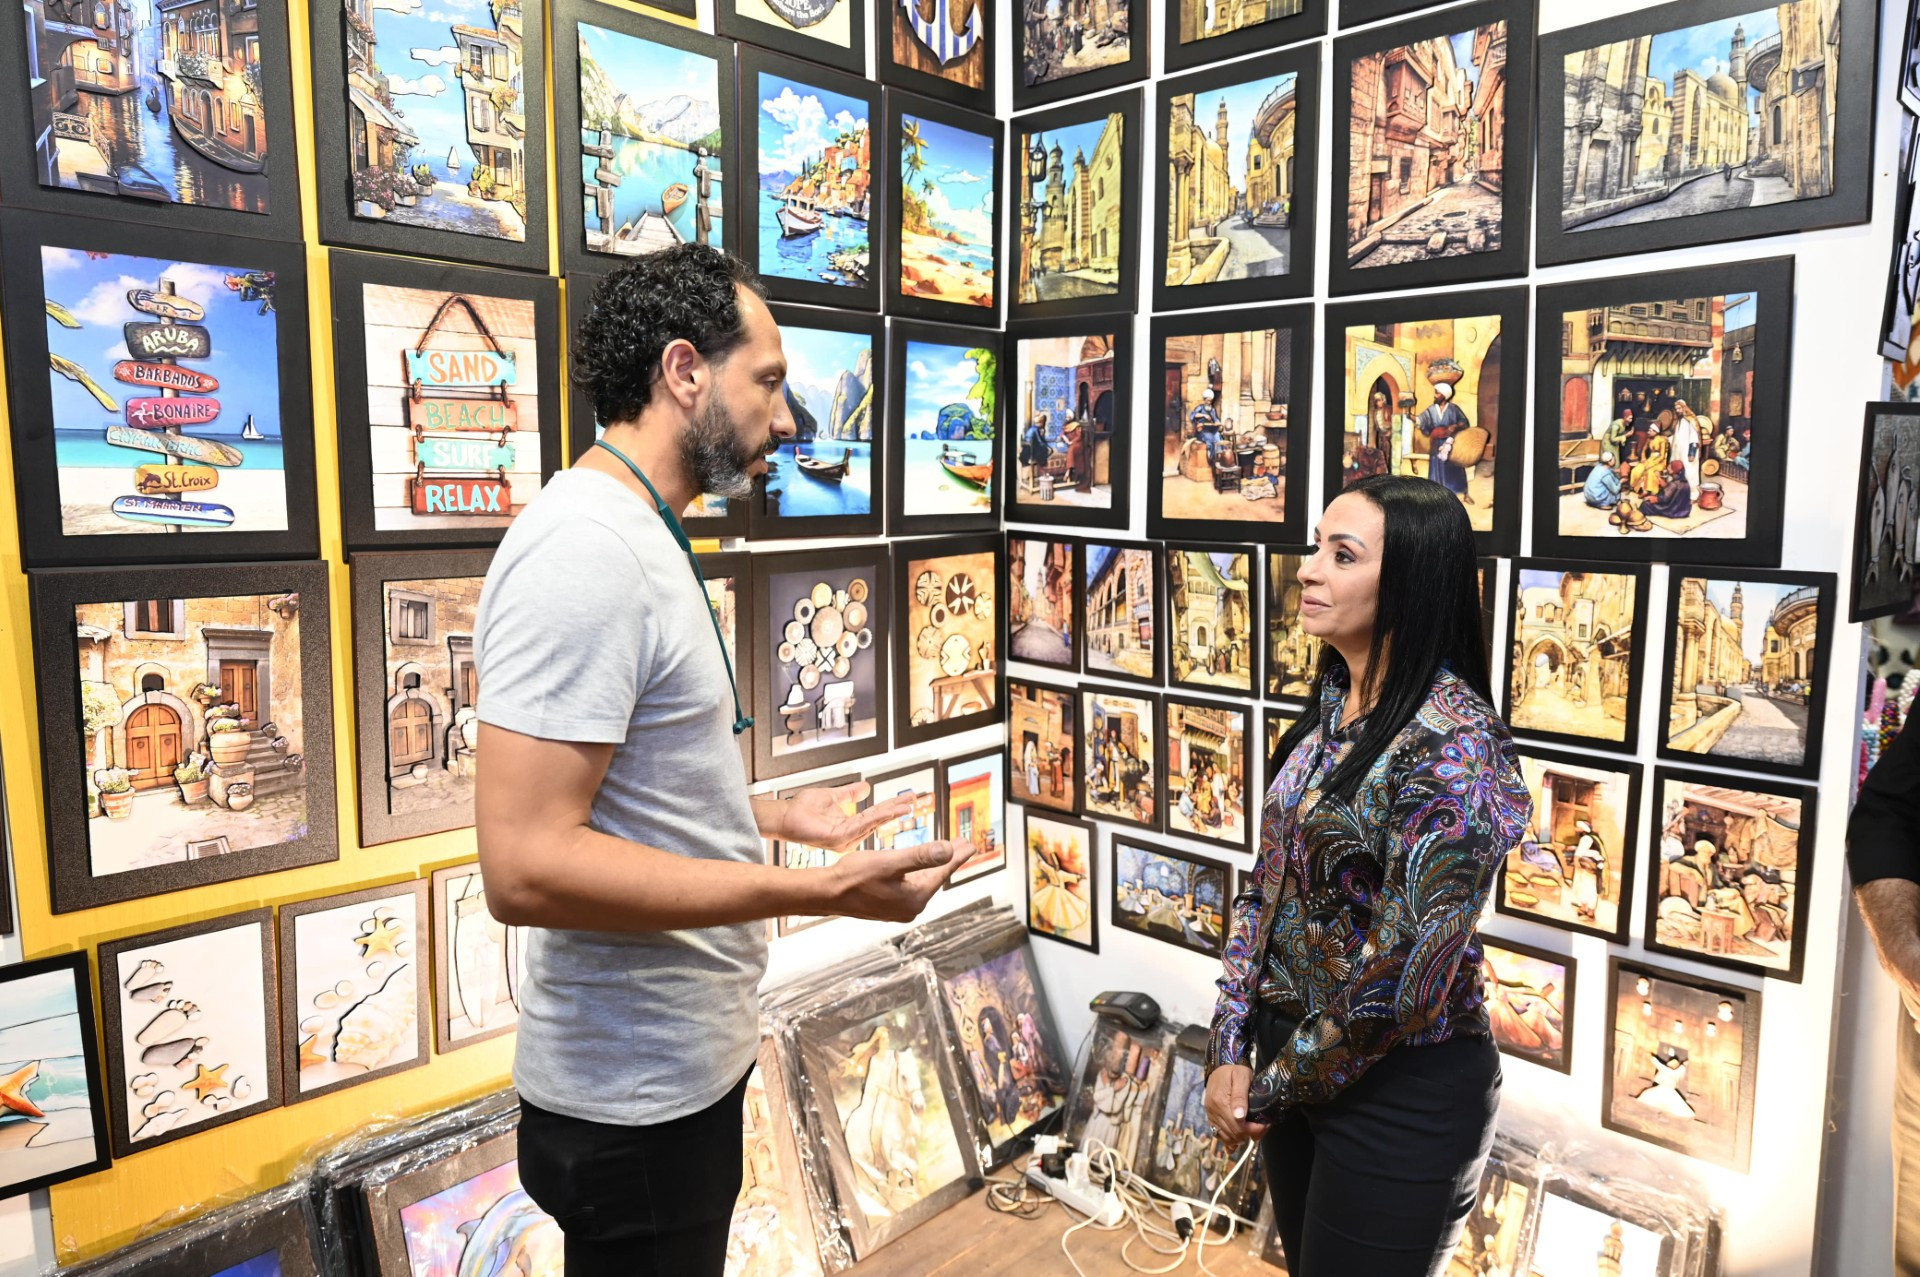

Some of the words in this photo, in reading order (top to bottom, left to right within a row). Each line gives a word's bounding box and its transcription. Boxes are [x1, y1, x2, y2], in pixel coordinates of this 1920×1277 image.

[142, 327, 199, 352] ARUBA
[135, 365, 202, 388] BARBADOS
[429, 352, 498, 383] SAND
[424, 402, 505, 429] BEACH
[432, 441, 496, 468] SURF
[424, 484, 502, 513] RELAX
